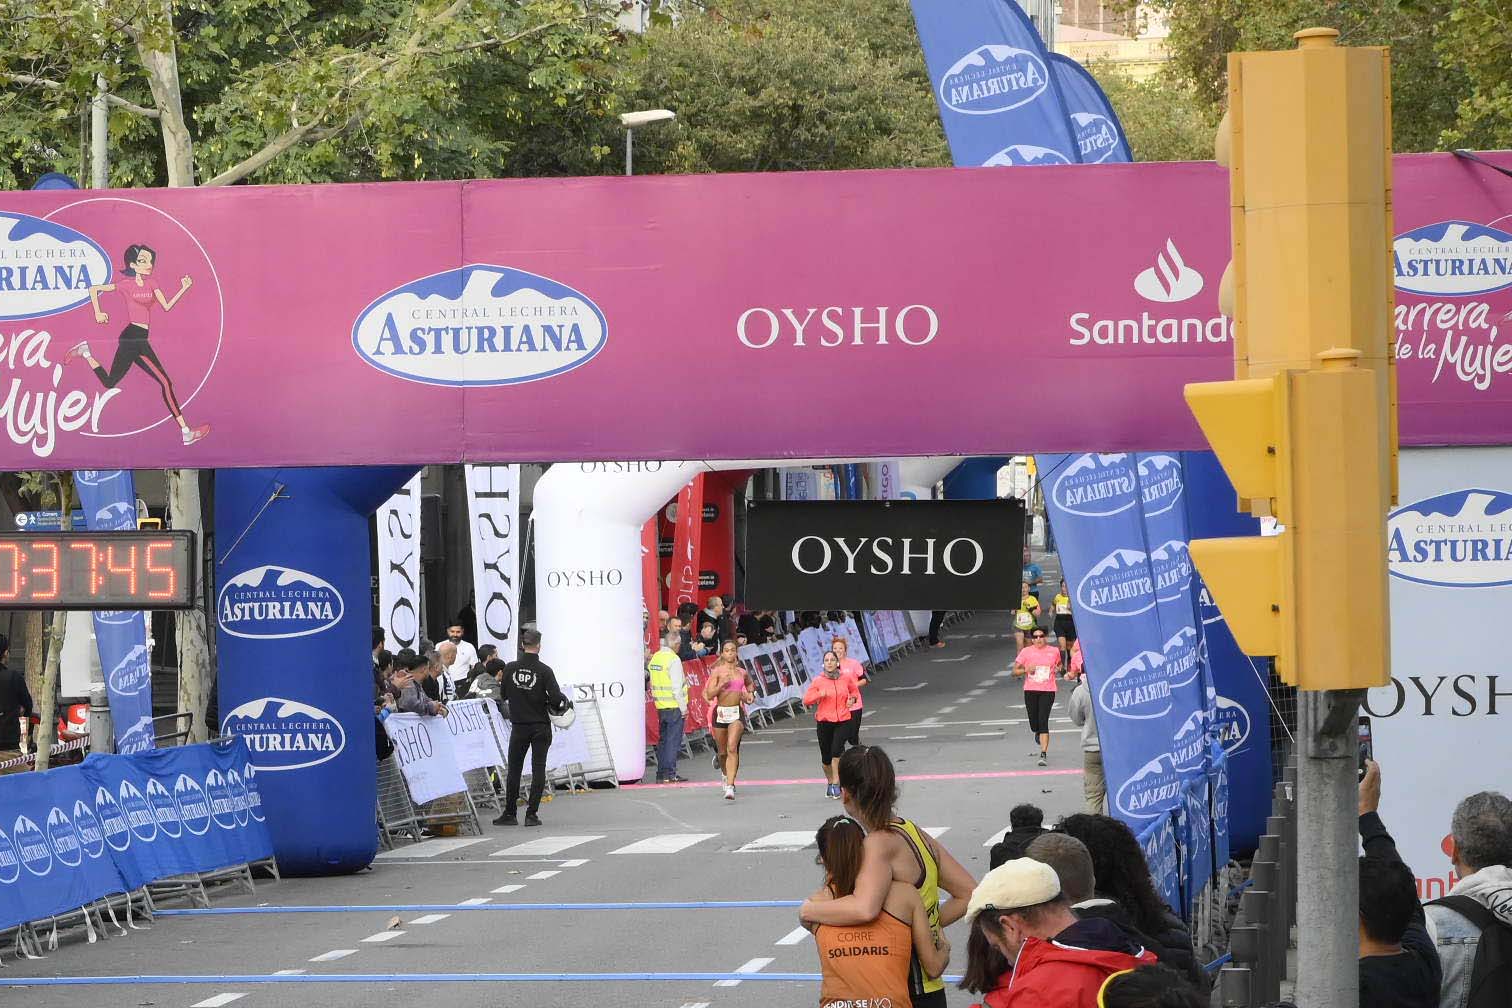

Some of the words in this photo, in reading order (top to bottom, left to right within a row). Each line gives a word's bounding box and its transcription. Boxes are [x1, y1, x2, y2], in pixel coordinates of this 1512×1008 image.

[14, 248, 88, 259] LECHERA
[1409, 246, 1463, 255] CENTRAL
[1465, 245, 1511, 254] LECHER
[412, 306, 491, 319] CENTRAL
[498, 304, 580, 318] LECHERA
[1394, 302, 1490, 331] arrera
[372, 311, 588, 357] ASTURIANA
[736, 304, 940, 349] OYSHO
[1069, 312, 1234, 346] Santand
[1418, 330, 1437, 359] la
[1431, 325, 1512, 391] Muje
[1415, 524, 1483, 534] CENTRAL
[791, 535, 985, 576] OYSHO
[1388, 527, 1512, 563] ASTURI
[547, 568, 624, 589] OYSHO
[234, 590, 279, 599] CENTRAL
[281, 590, 331, 600] LECHERA
[222, 594, 336, 623] ASTURIANA
[518, 673, 531, 682] BP
[576, 680, 625, 699] SHO
[1363, 674, 1512, 718] OYSH
[235, 721, 280, 730] CENTRAL
[281, 721, 331, 730] LECHERA
[225, 727, 336, 753] TURIANA
[837, 930, 875, 943] CORRE
[828, 946, 889, 959] SOLIDARIS
